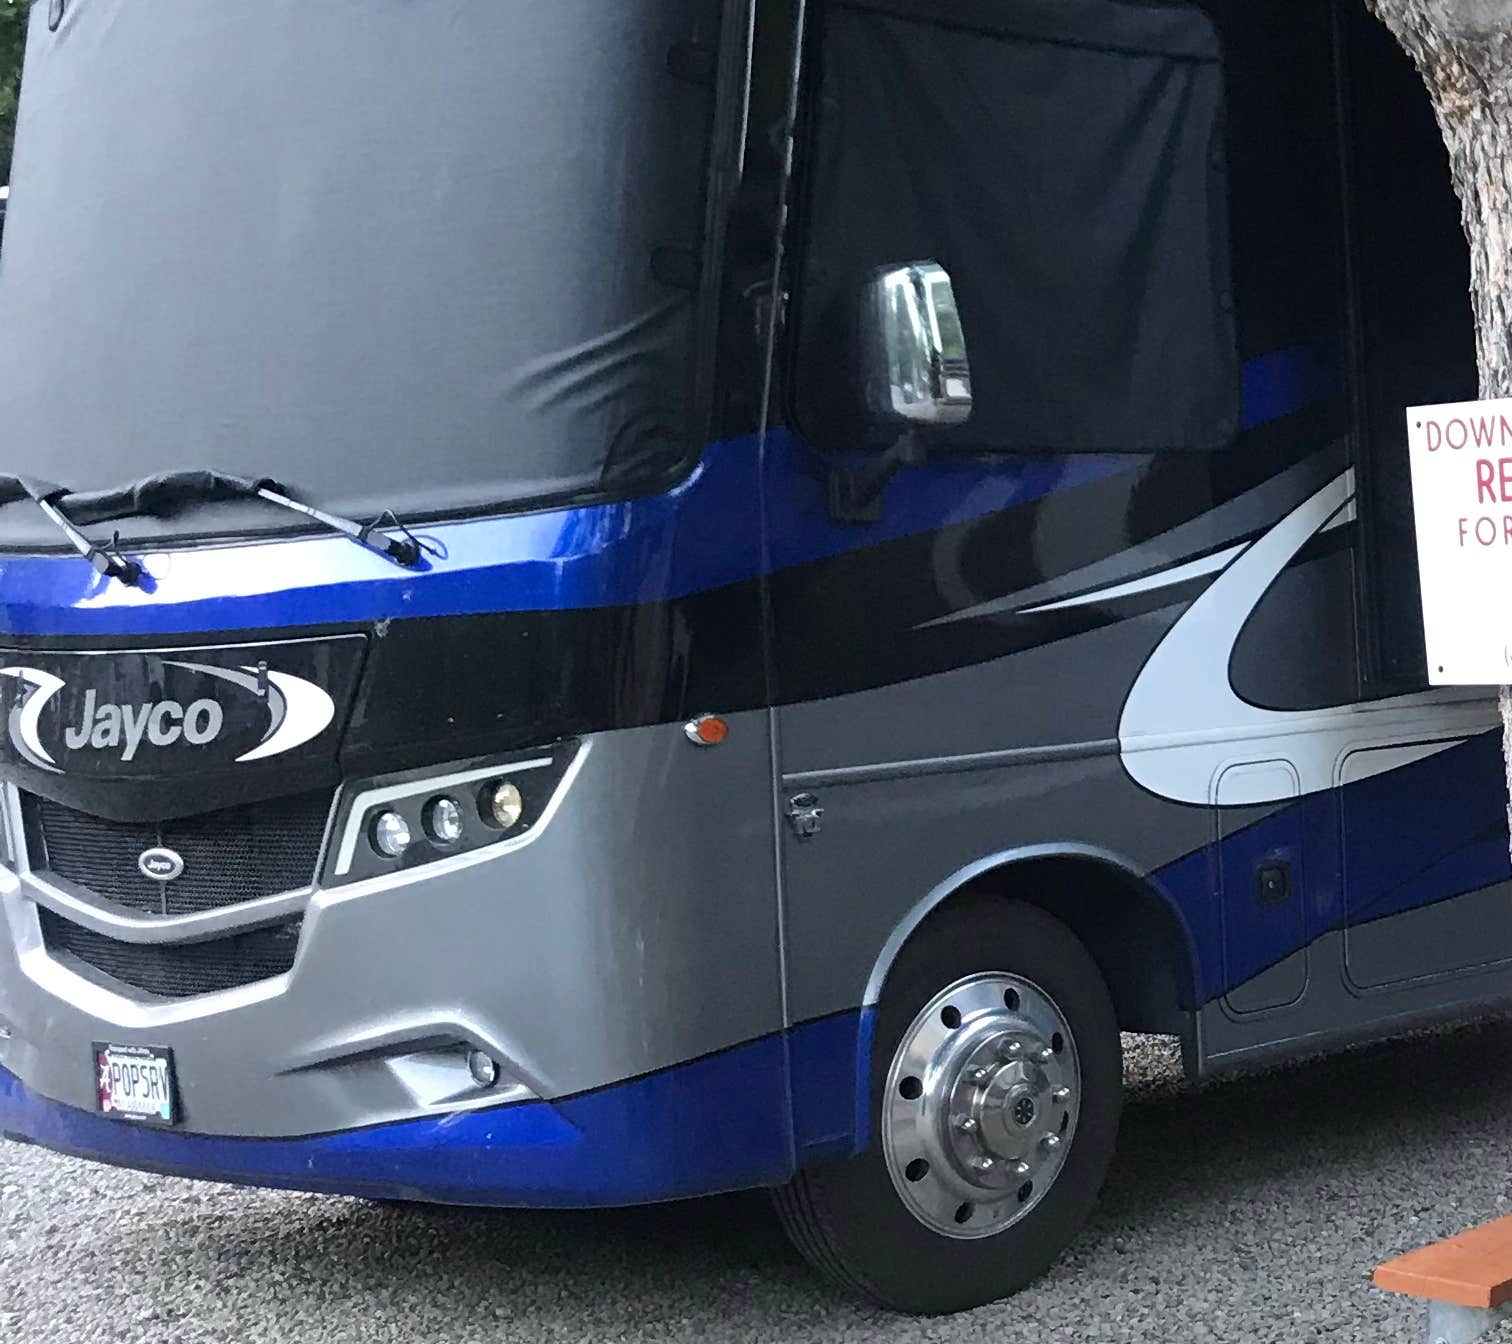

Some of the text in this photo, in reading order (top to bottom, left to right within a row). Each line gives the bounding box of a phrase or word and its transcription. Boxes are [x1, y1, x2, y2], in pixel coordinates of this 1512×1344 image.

[65, 689, 224, 761] Jayco
[147, 858, 172, 871] Jayco
[111, 1062, 169, 1101] POPSRV
